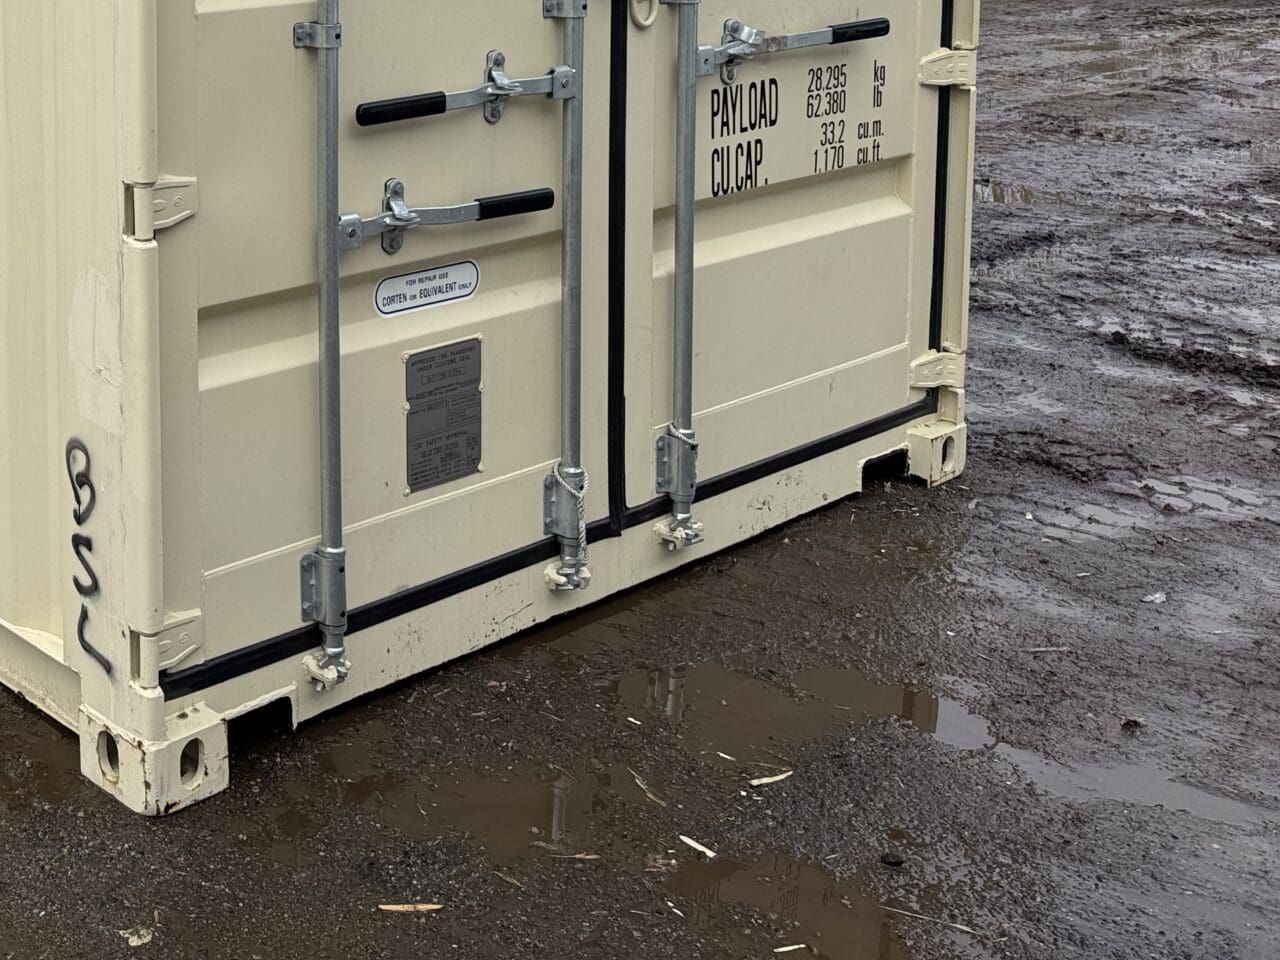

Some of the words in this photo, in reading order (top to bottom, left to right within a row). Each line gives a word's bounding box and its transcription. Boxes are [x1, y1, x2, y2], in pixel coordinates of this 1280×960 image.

[711, 78, 778, 140] PAYLOAD
[807, 64, 847, 93] 28,295
[873, 60, 886, 87] kg
[806, 89, 846, 119] 62,380
[873, 85, 882, 108] lb
[820, 119, 845, 146] 33.2
[418, 274, 437, 284] REPAIR
[382, 292, 407, 307] CORTEN
[419, 281, 457, 299] EQUIVALENT
[458, 282, 472, 291] ONLY
